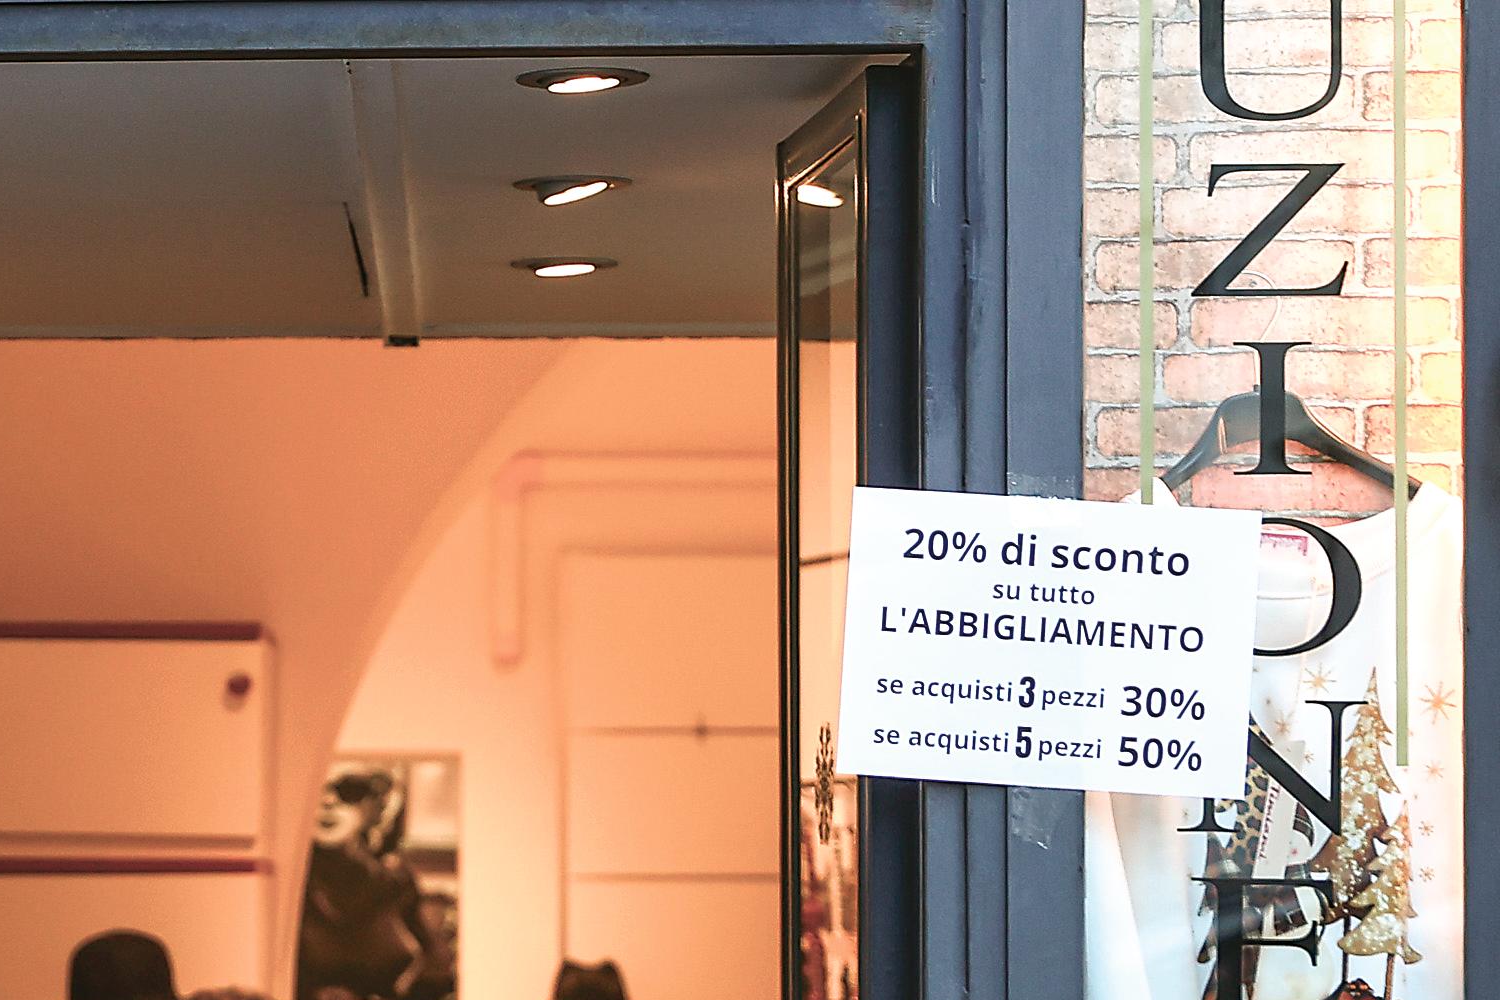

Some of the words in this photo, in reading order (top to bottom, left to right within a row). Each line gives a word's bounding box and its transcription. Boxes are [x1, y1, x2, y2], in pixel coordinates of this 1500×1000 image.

[903, 528, 987, 564] 20%
[1001, 532, 1037, 567] di
[1051, 544, 1190, 577] sconto
[992, 584, 1021, 601] su
[1029, 583, 1095, 605] tutto
[881, 606, 1204, 653] L'ABBIGLIAMENTO
[876, 678, 904, 695] se
[911, 680, 1013, 705] acquisti
[1018, 676, 1036, 709] 3
[1041, 688, 1105, 711] pezzi
[1120, 685, 1205, 721] 30%
[873, 728, 900, 745] se
[908, 731, 1009, 755] acquisti
[1015, 725, 1033, 759] 5
[1038, 738, 1102, 762] pezzi
[1117, 736, 1202, 772] 50%
